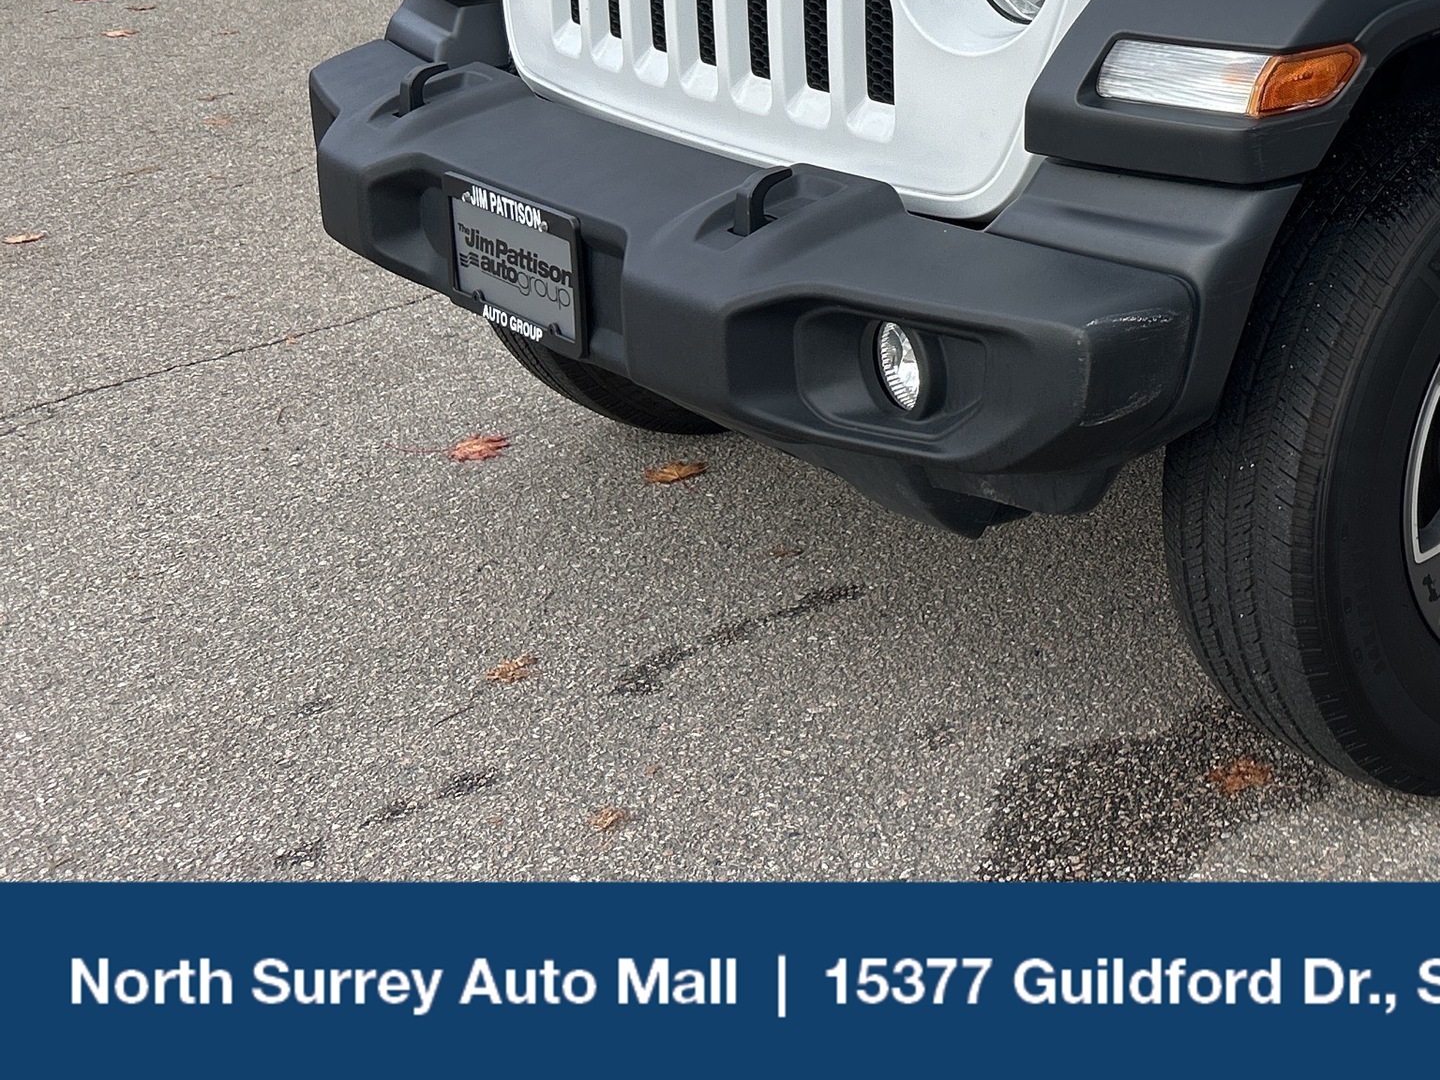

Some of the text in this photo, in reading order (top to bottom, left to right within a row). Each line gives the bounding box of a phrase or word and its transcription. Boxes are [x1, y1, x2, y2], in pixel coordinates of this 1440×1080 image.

[469, 185, 542, 231] JIM PATTISON
[457, 222, 471, 235] The
[482, 304, 543, 342] AUTO GROUP
